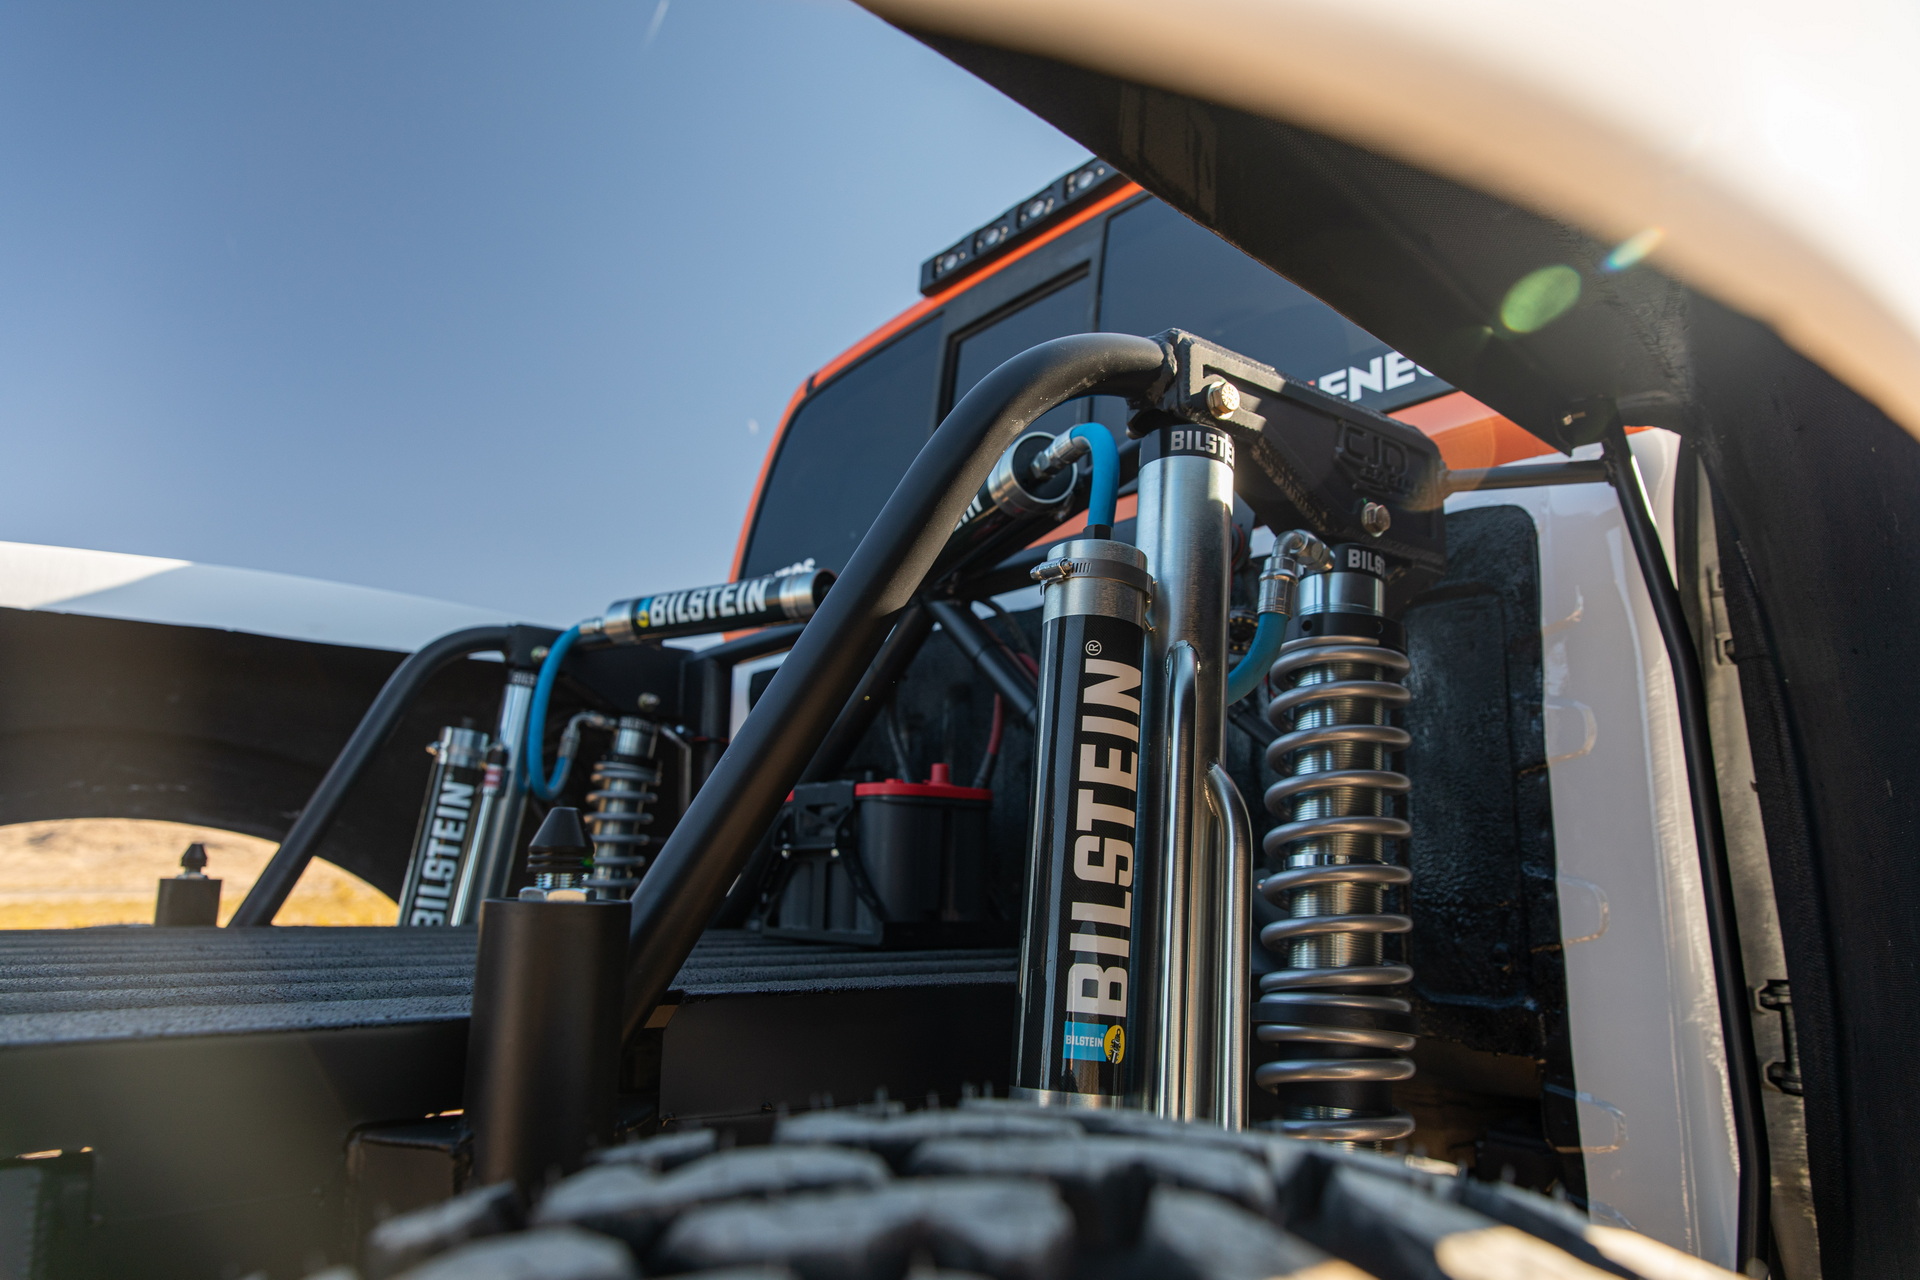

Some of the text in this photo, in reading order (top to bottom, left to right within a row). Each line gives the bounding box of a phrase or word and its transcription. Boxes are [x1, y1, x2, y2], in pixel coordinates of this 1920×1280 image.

[1319, 351, 1434, 402] ENE
[650, 578, 770, 627] BILSTEIN
[410, 780, 475, 926] BILSTEIN
[1065, 1035, 1103, 1048] BILSTEIN
